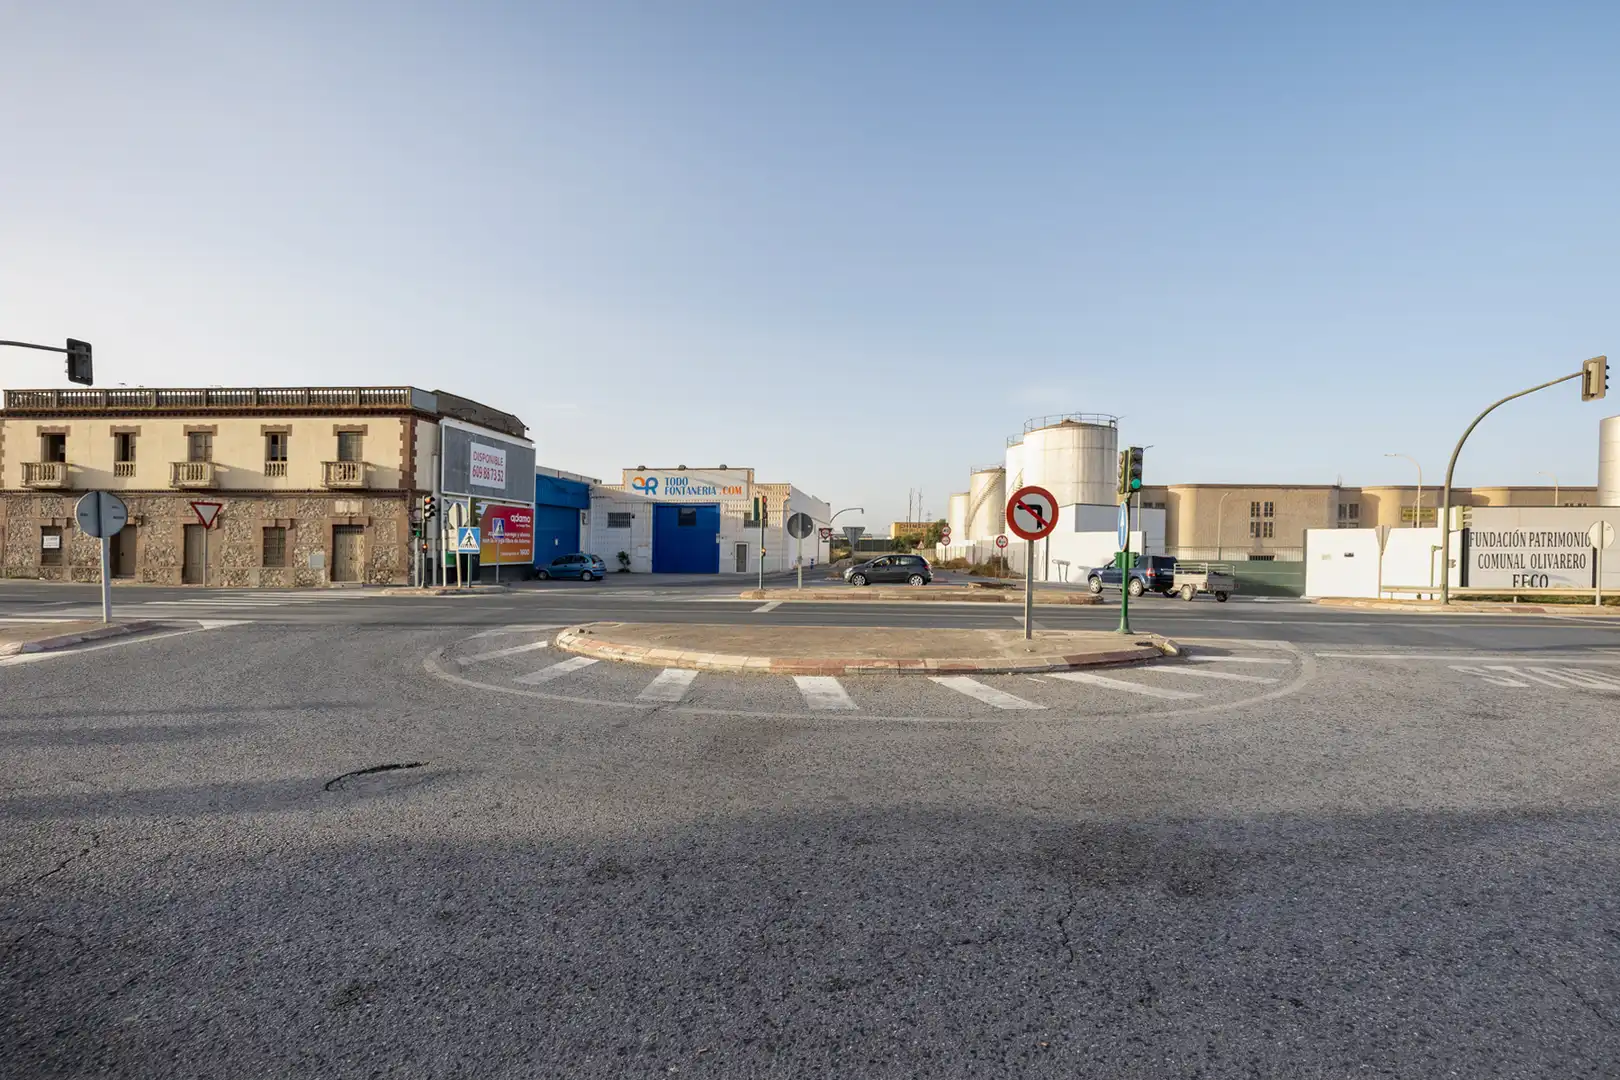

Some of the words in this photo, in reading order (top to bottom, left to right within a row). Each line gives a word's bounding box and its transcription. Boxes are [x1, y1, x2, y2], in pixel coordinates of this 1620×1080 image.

[473, 451, 503, 466] DISPONIBLE
[472, 465, 482, 479] 609
[483, 466, 490, 480] 88
[491, 467, 497, 481] 73
[497, 468, 504, 482] 52
[664, 477, 688, 486] TODO
[664, 486, 716, 496] FONTANERIA
[510, 514, 530, 523] adamo
[1469, 529, 1526, 548] FUNDACIÓN
[1478, 553, 1525, 569] COMUNAL
[1530, 553, 1586, 569] OLIVARERO
